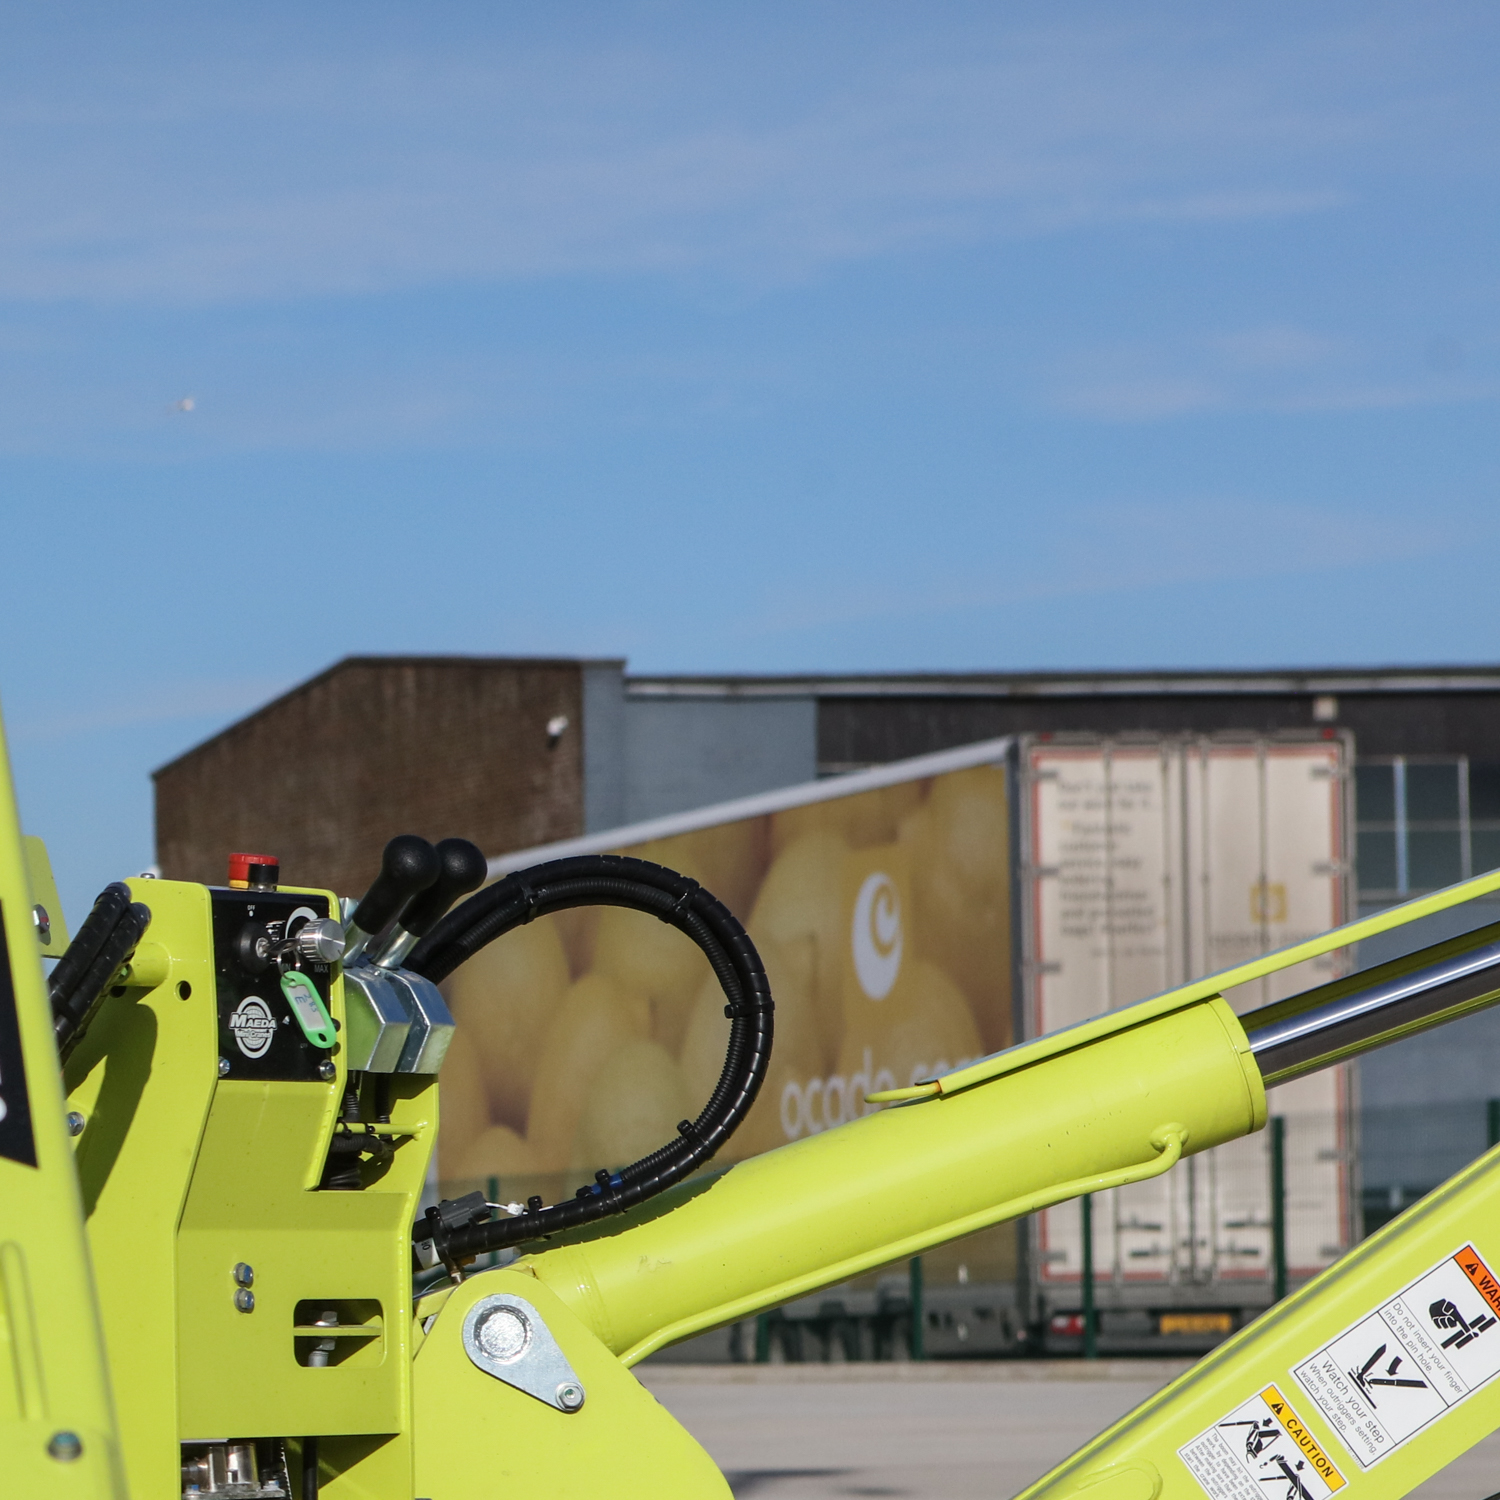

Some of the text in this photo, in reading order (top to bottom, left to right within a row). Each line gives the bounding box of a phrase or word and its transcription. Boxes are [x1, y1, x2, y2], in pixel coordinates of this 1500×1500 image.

[229, 1011, 277, 1030] MAEDA
[1384, 1309, 1432, 1373] into the pin hole.
[1393, 1303, 1463, 1393] Do not insert your finger
[1301, 1371, 1346, 1435] watch your step.
[1310, 1363, 1327, 1387] When
[1327, 1388, 1356, 1425] outriggers
[1355, 1426, 1377, 1455] setting,
[1322, 1360, 1384, 1443] Watch your step
[1184, 1453, 1194, 1463] start
[1200, 1474, 1210, 1485] crane
[1190, 1448, 1204, 1467] between
[1211, 1477, 1228, 1498] outriggers
[1201, 1442, 1216, 1460] outrigger
[1221, 1468, 1230, 1479] have
[1229, 1478, 1238, 1490] been
[1218, 1443, 1229, 1455] boom
[1228, 1457, 1237, 1466] may
[1221, 1459, 1238, 1480] depending
[1287, 1419, 1333, 1477] CAUTION
[1204, 1457, 1217, 1473] making
[1216, 1473, 1224, 1483] sure
[1224, 1483, 1232, 1493] that
